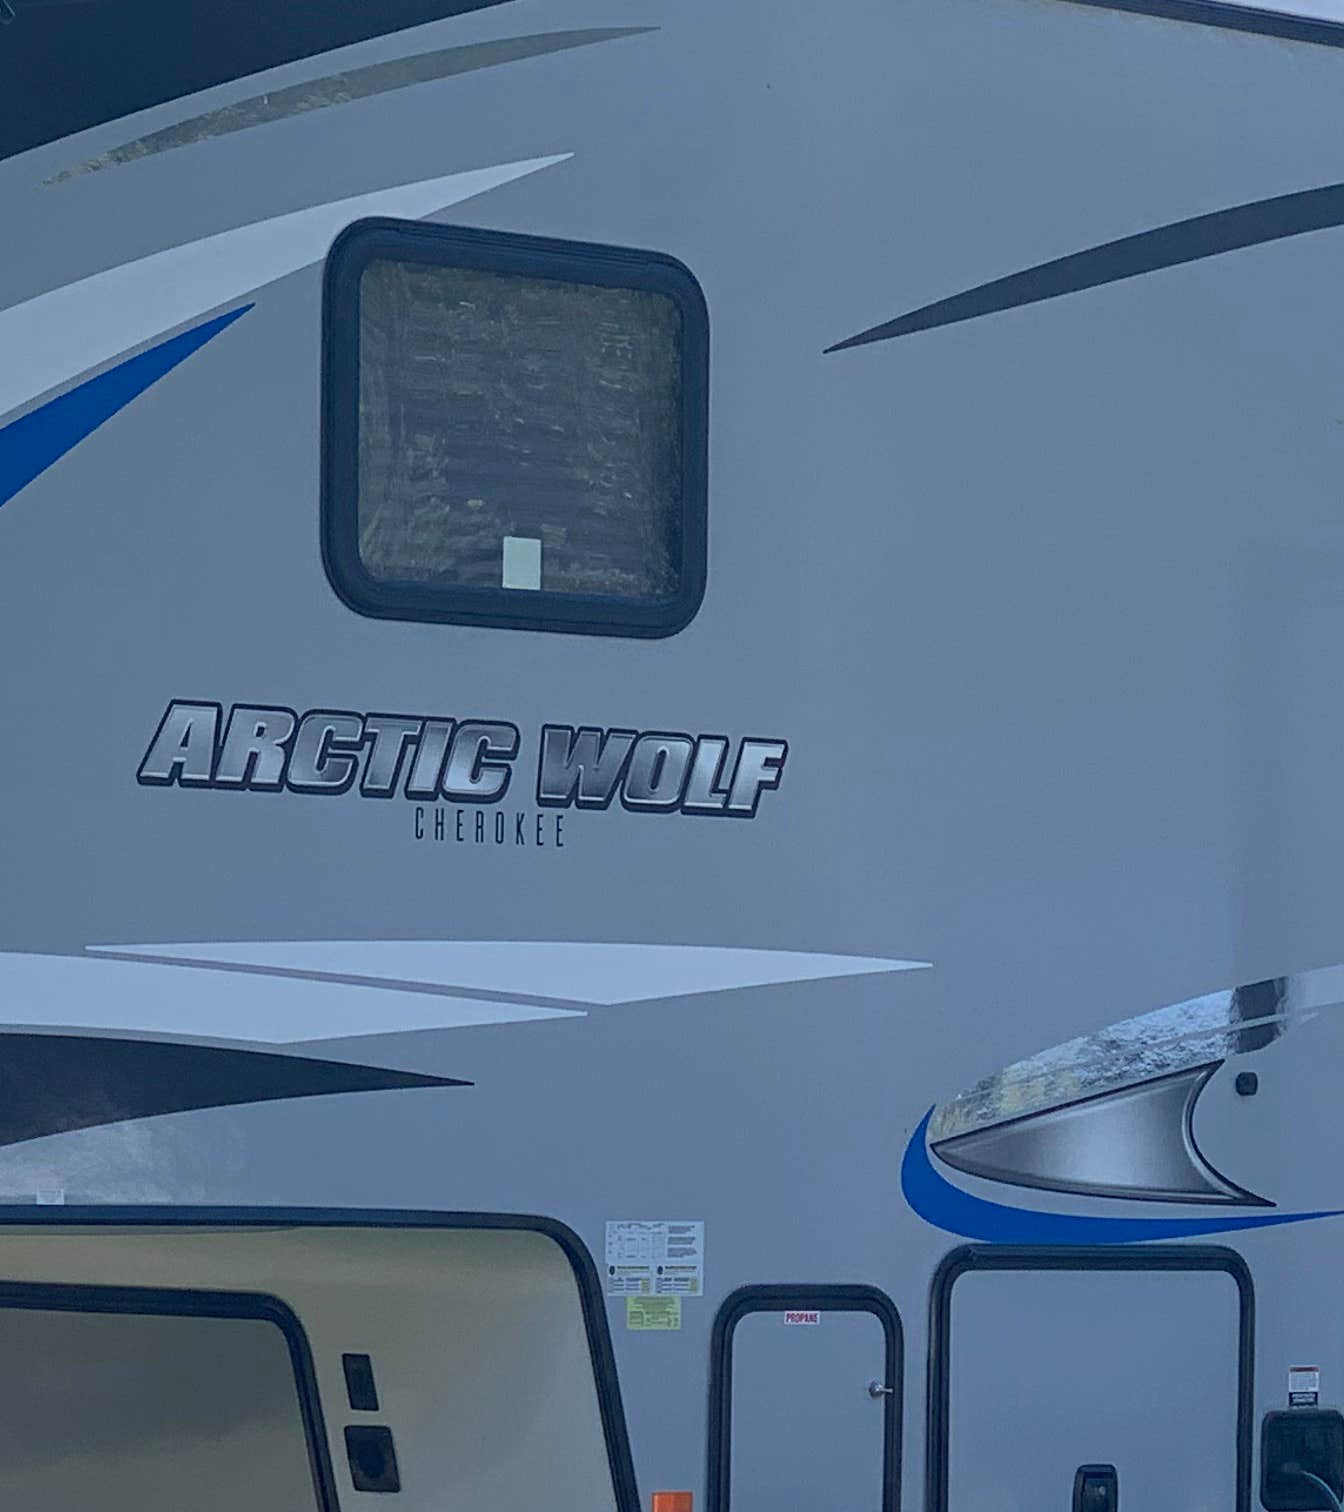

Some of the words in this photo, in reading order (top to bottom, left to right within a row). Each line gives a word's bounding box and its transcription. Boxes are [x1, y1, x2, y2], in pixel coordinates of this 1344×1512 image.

[136, 699, 521, 805] ARCTIC
[536, 723, 788, 819] WOLF
[415, 806, 565, 847] CHEROKEE
